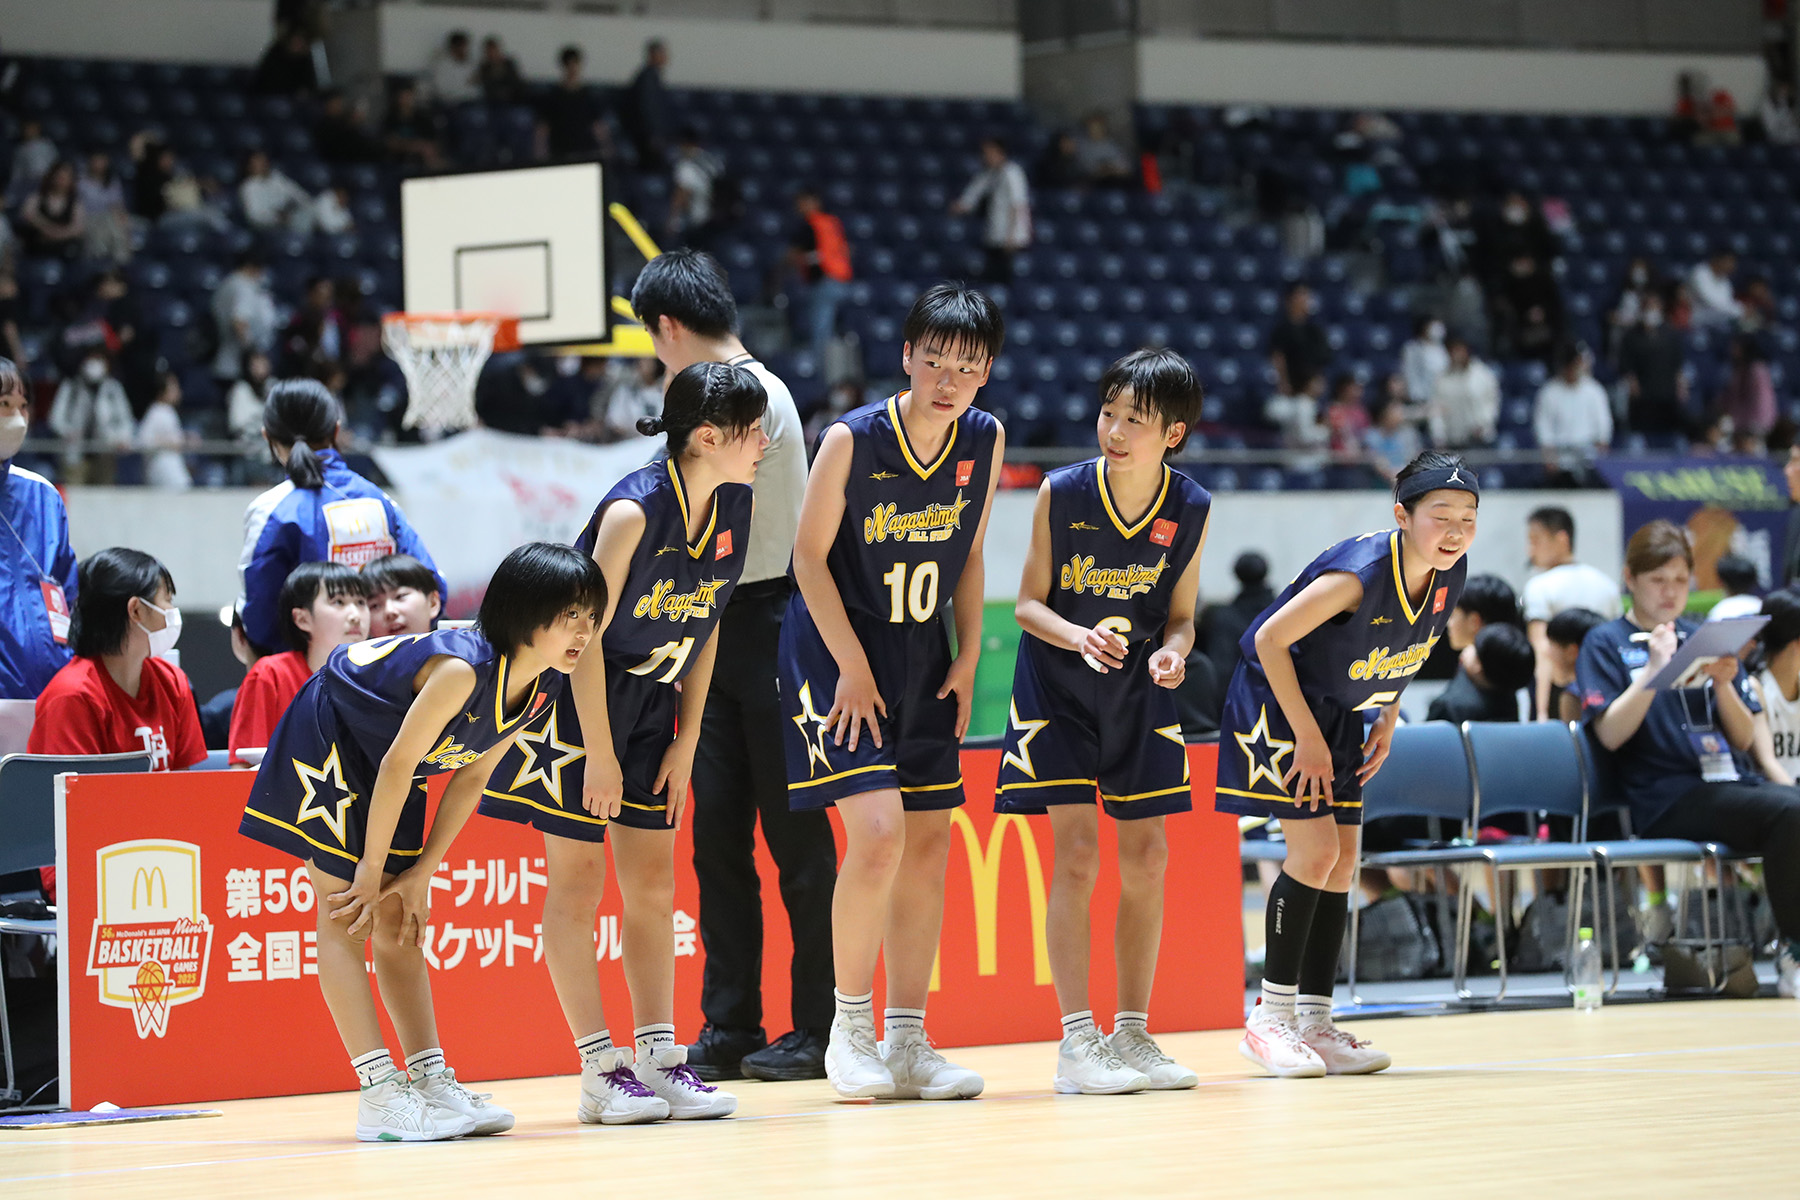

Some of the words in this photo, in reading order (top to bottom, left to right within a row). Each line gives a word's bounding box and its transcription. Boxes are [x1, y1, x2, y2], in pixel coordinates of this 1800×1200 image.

[907, 531, 928, 542] ALL
[883, 560, 940, 623] 10
[1107, 587, 1129, 600] ALL
[625, 636, 696, 684] 11
[172, 919, 204, 935] Mini
[98, 936, 199, 964] BASKETBALL
[173, 961, 199, 973] GAMES
[177, 973, 197, 985] 2025
